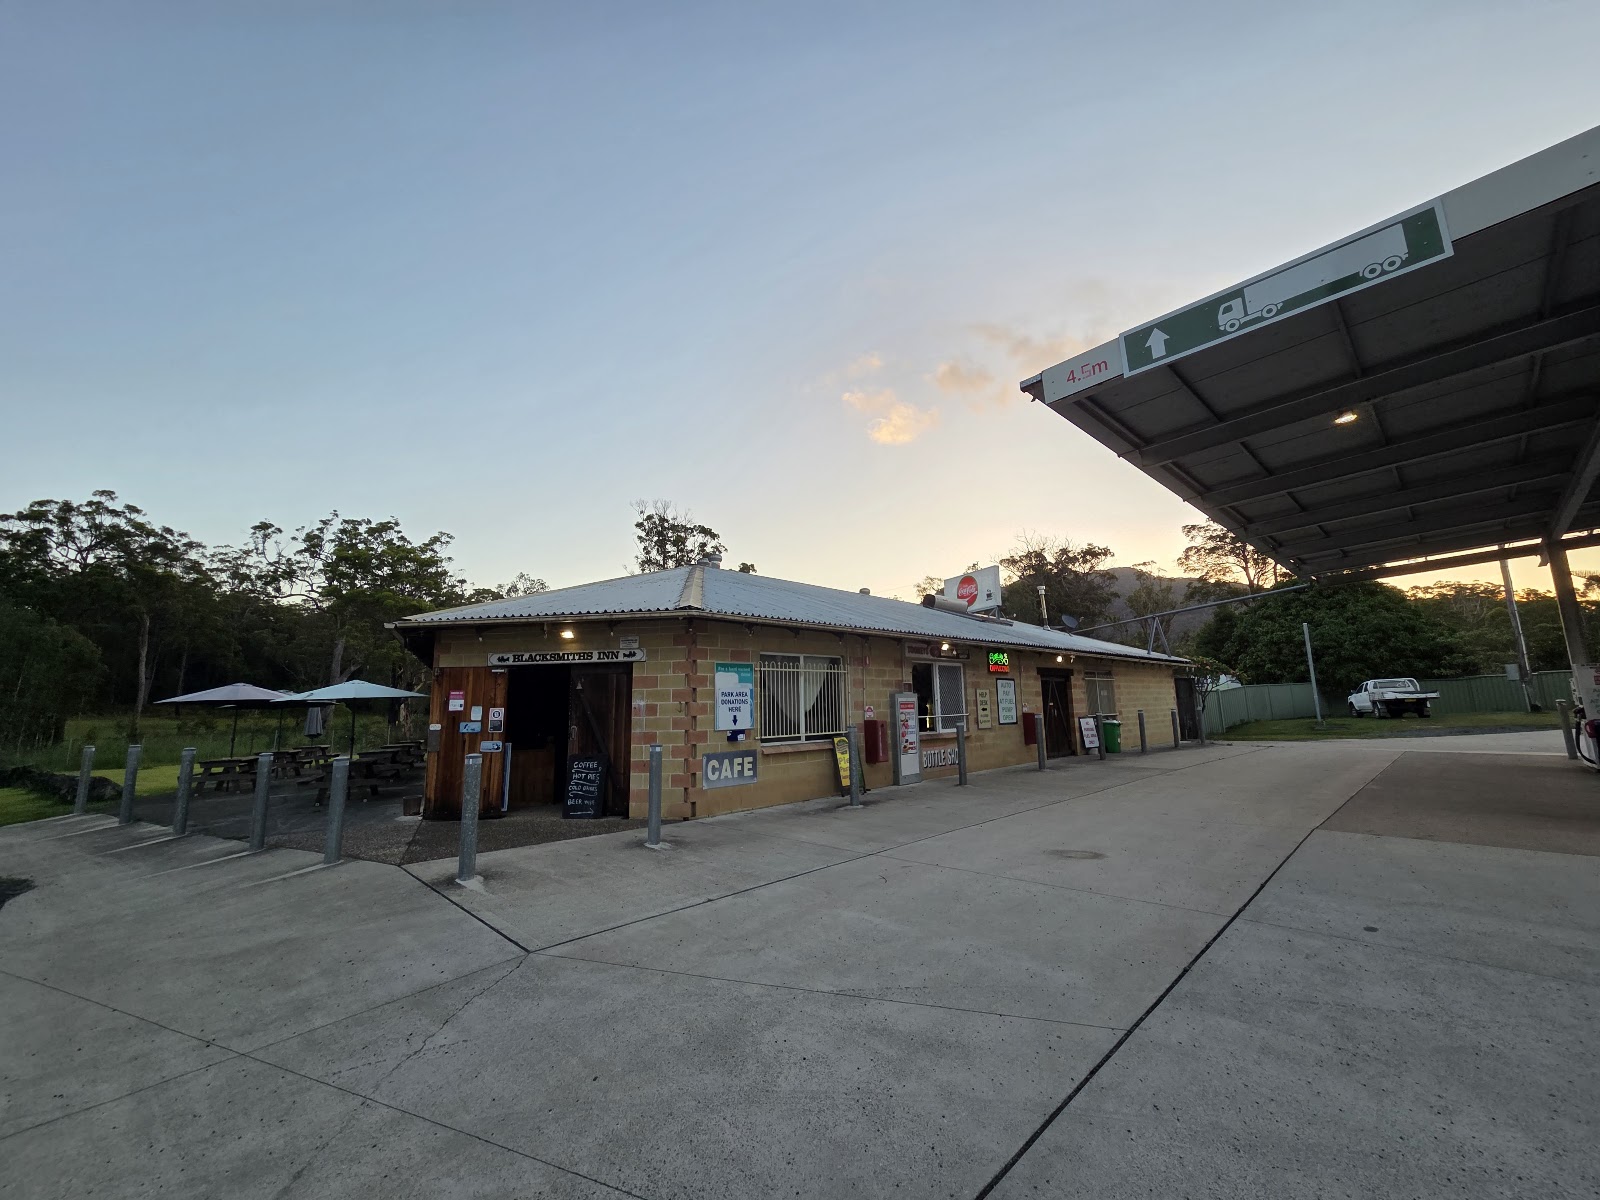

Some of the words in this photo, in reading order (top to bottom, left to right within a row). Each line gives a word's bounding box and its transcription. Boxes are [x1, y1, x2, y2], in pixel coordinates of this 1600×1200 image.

[1066, 359, 1108, 384] 4.5m
[512, 652, 593, 663] BLACKSMITHS
[597, 651, 620, 660] INN
[923, 749, 946, 768] BOTTLE
[947, 748, 959, 765] SHO
[707, 756, 754, 781] CAFE
[567, 798, 582, 806] BEER
